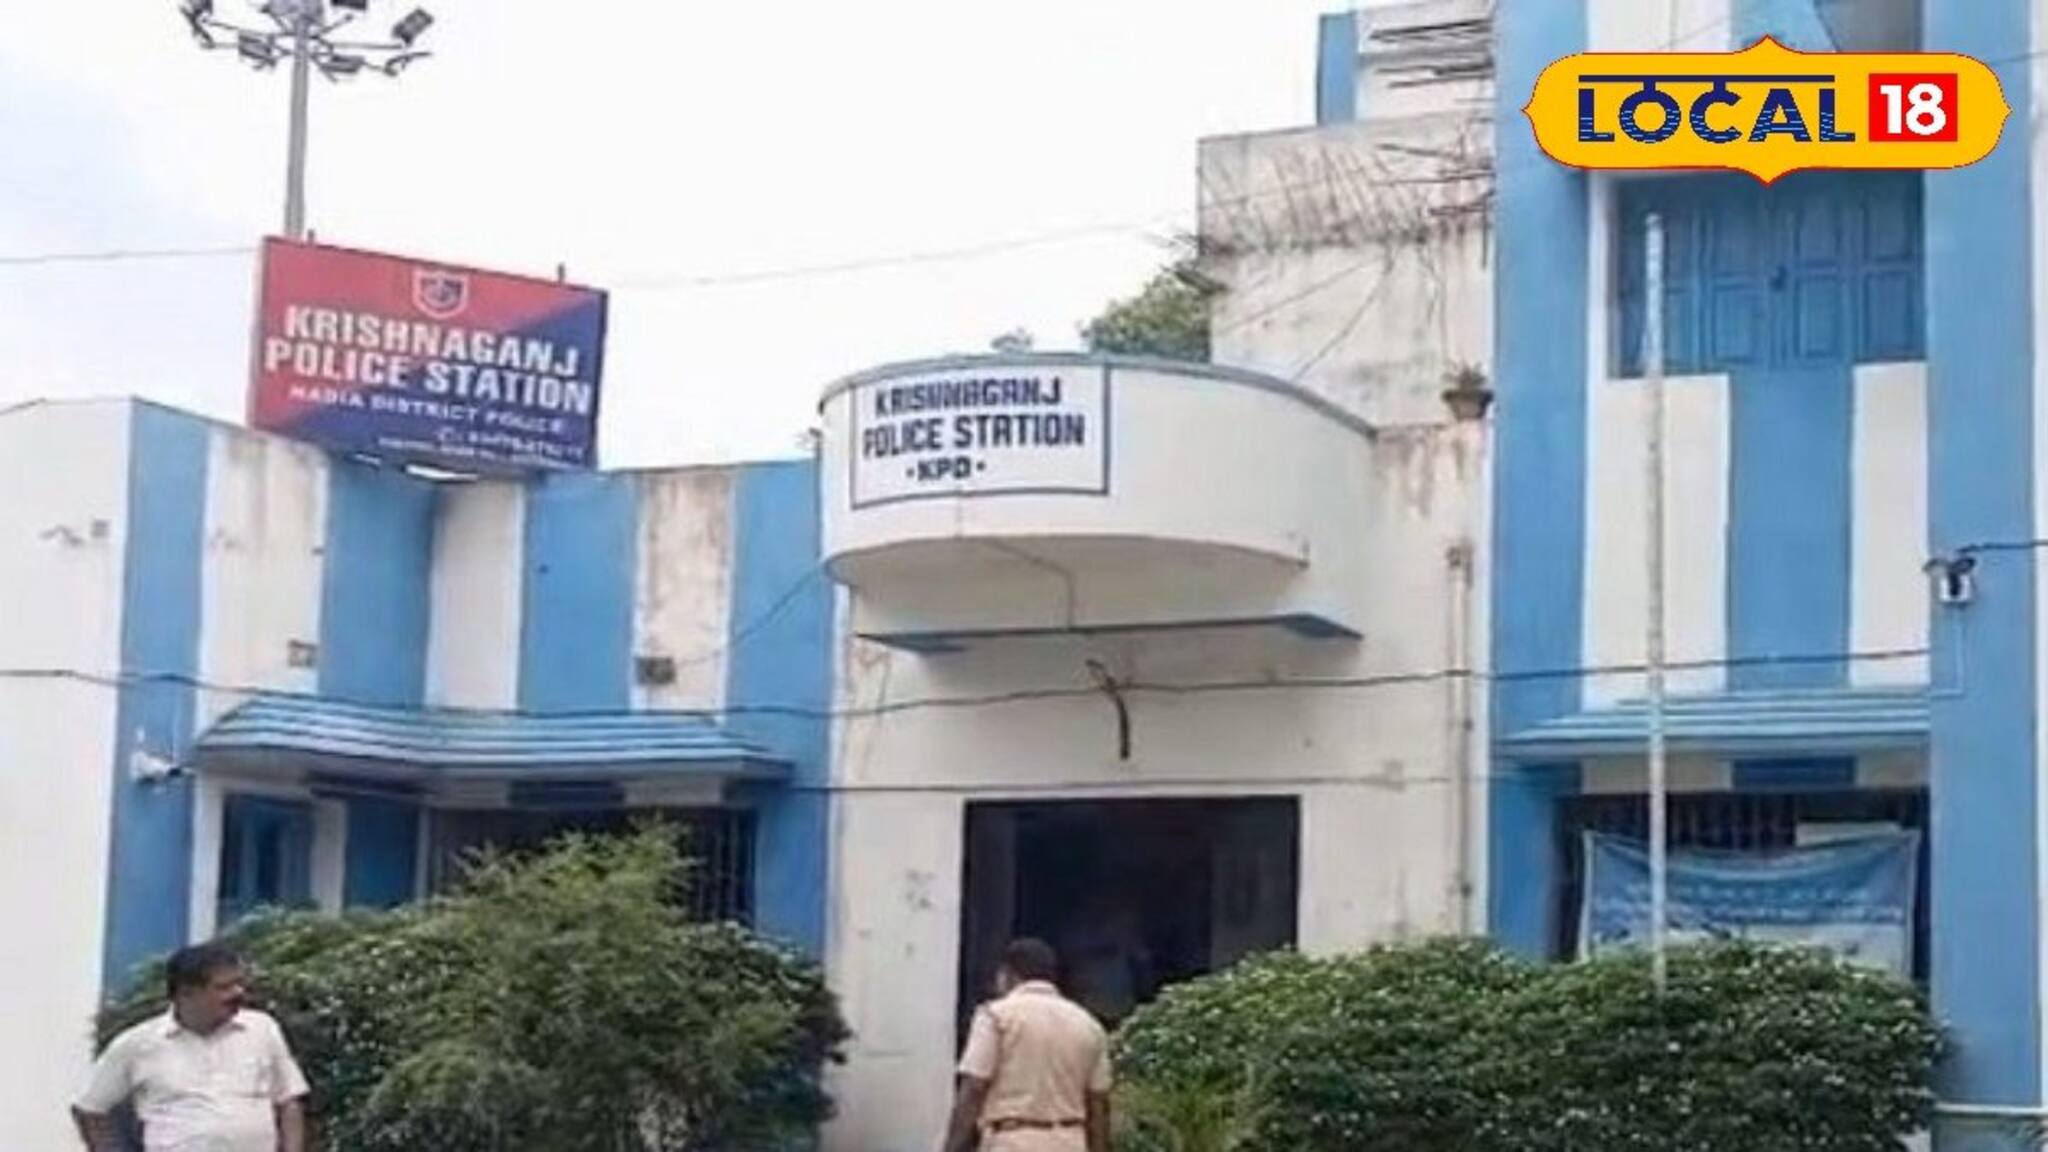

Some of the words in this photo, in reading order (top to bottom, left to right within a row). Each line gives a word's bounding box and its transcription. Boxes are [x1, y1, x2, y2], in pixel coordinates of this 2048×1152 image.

[285, 305, 579, 377] KRISHNAGANJ
[265, 338, 409, 389] POLICE
[424, 361, 592, 414] STATION
[875, 377, 1062, 416] KRISHNAGANJ
[863, 417, 943, 460] POLICE
[954, 413, 1085, 449] STATION
